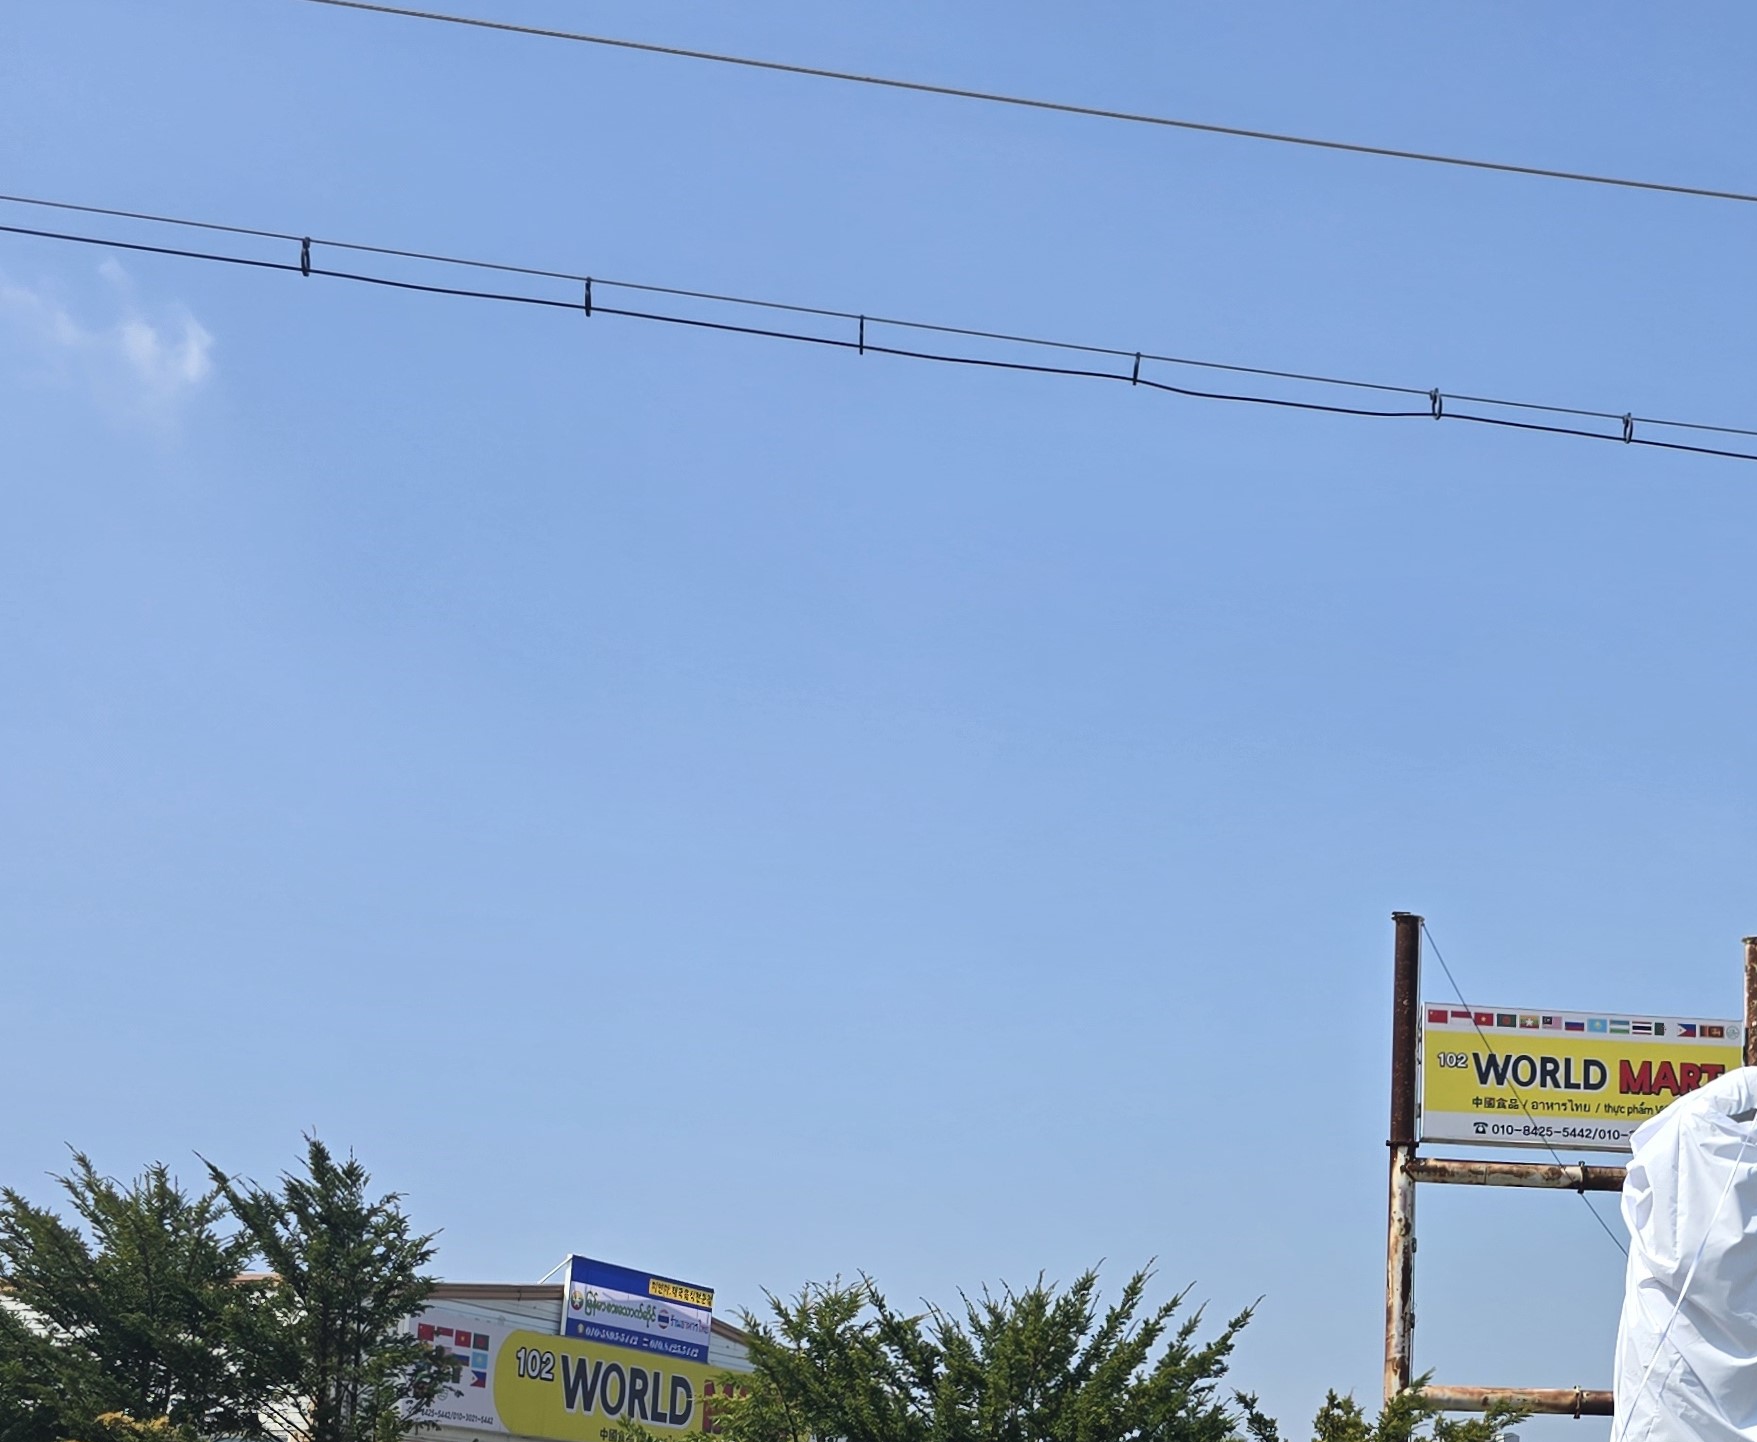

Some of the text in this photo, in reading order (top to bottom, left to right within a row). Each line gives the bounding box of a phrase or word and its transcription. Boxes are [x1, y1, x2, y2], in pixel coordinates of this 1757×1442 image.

[1437, 1052, 1468, 1068] 102
[1472, 1052, 1608, 1091] WORLD
[1472, 1096, 1520, 1110] 中國食品
[1531, 1099, 1591, 1113] อาหารไทย
[516, 1347, 555, 1380] 102
[561, 1354, 693, 1426] WORLD
